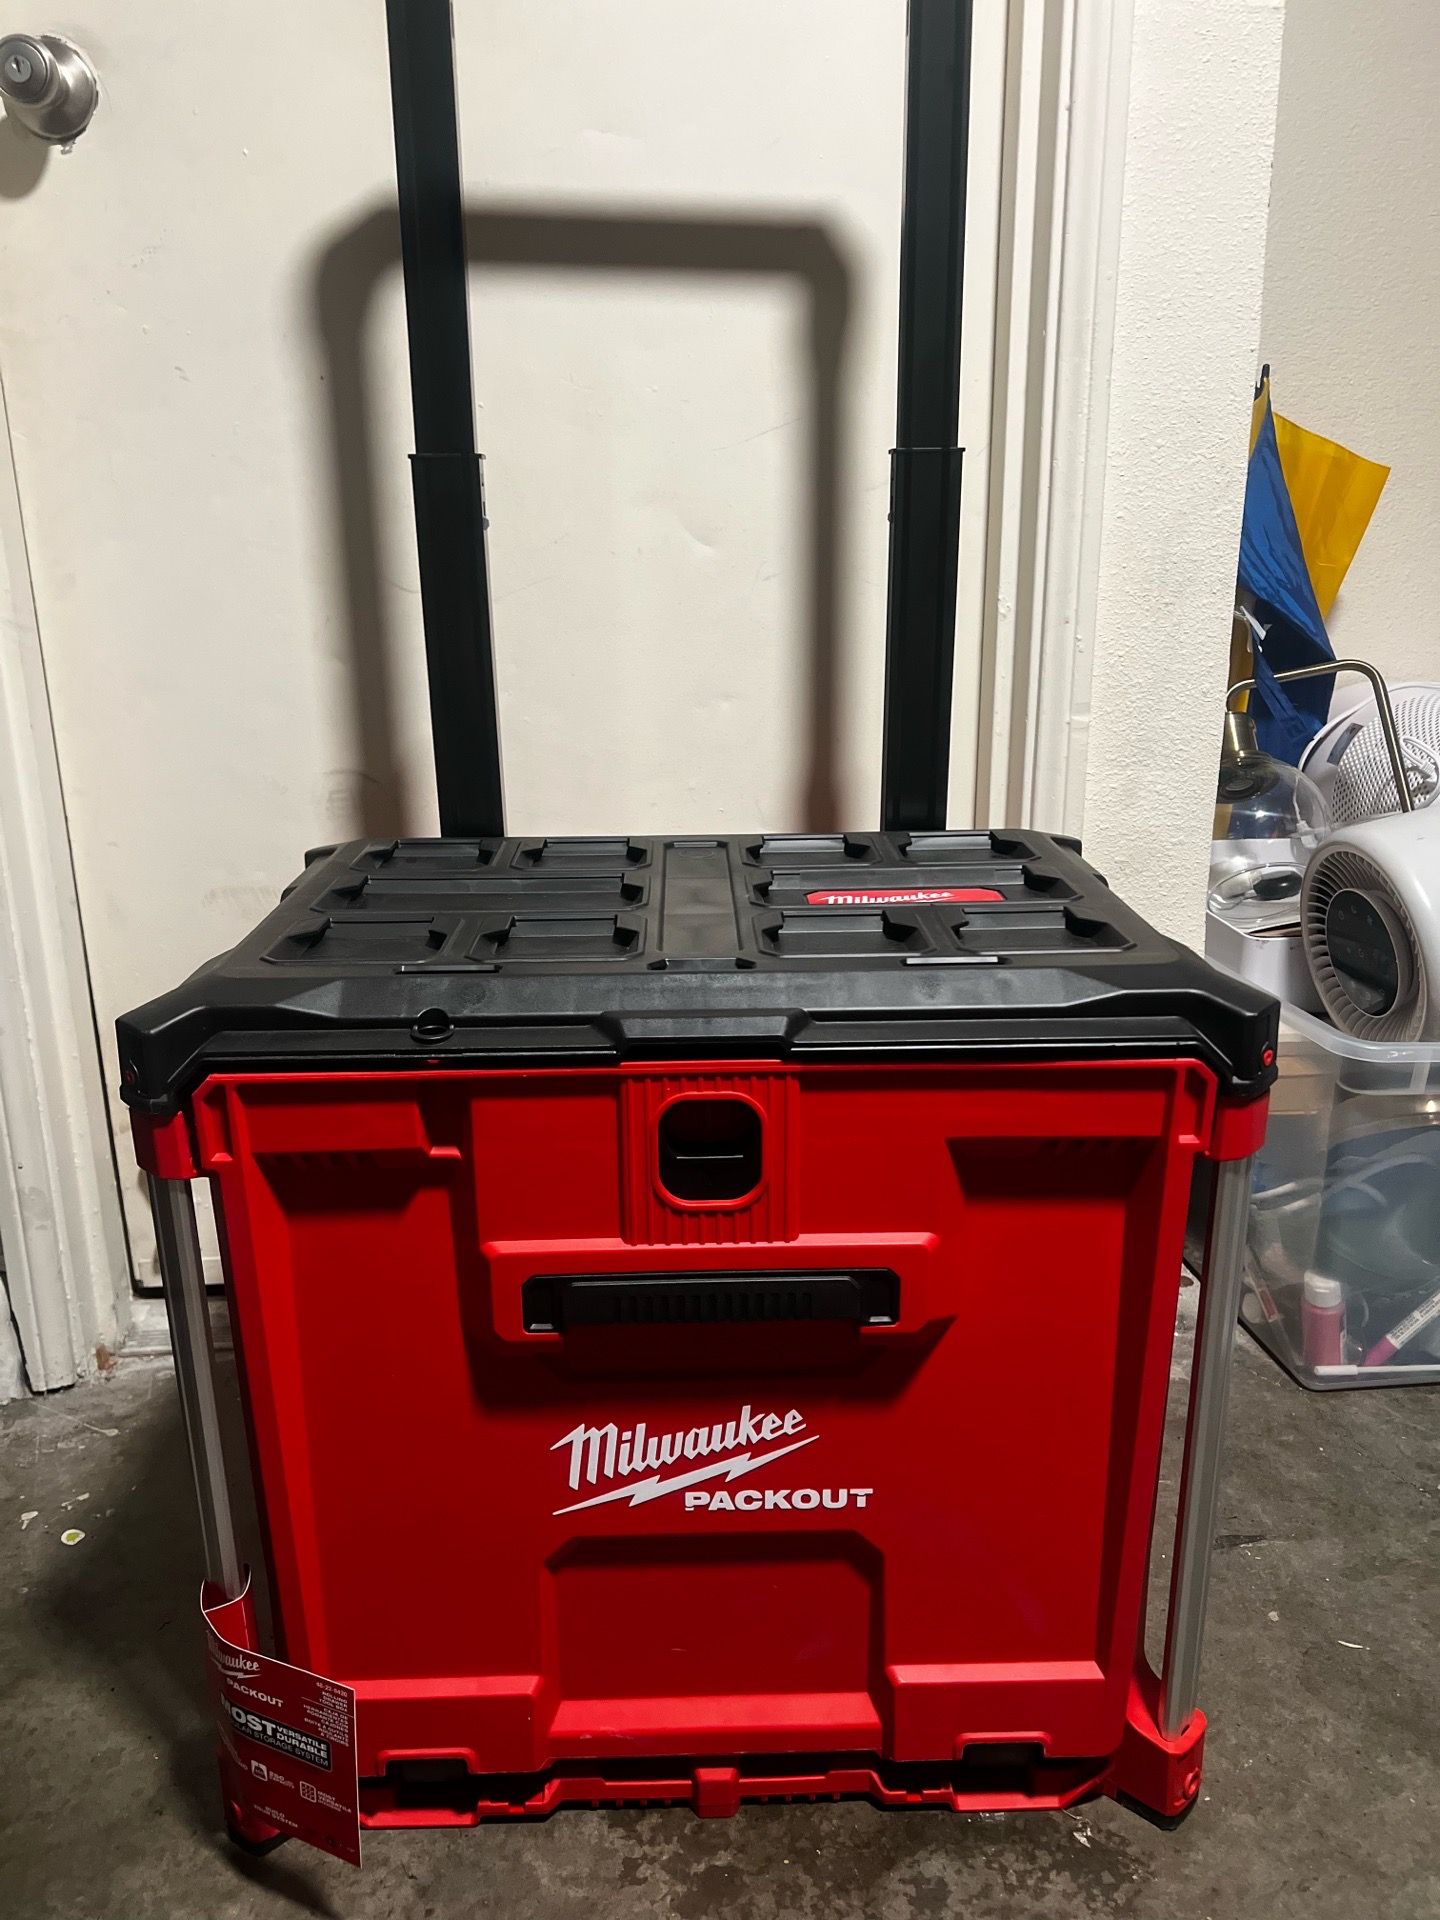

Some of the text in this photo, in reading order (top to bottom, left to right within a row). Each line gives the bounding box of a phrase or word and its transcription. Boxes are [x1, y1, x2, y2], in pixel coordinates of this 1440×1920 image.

[819, 891, 956, 905] Milwaukee
[550, 1404, 807, 1490] Milwaukee
[685, 1488, 874, 1511] PACKOUT
[226, 1678, 284, 1708] PACKOUT
[221, 1692, 276, 1736] MOST
[253, 1730, 294, 1753] STORAGE
[294, 1748, 329, 1767] SYSTEM
[276, 1725, 328, 1751] VERSATILE
[276, 1732, 329, 1759] DURABLE
